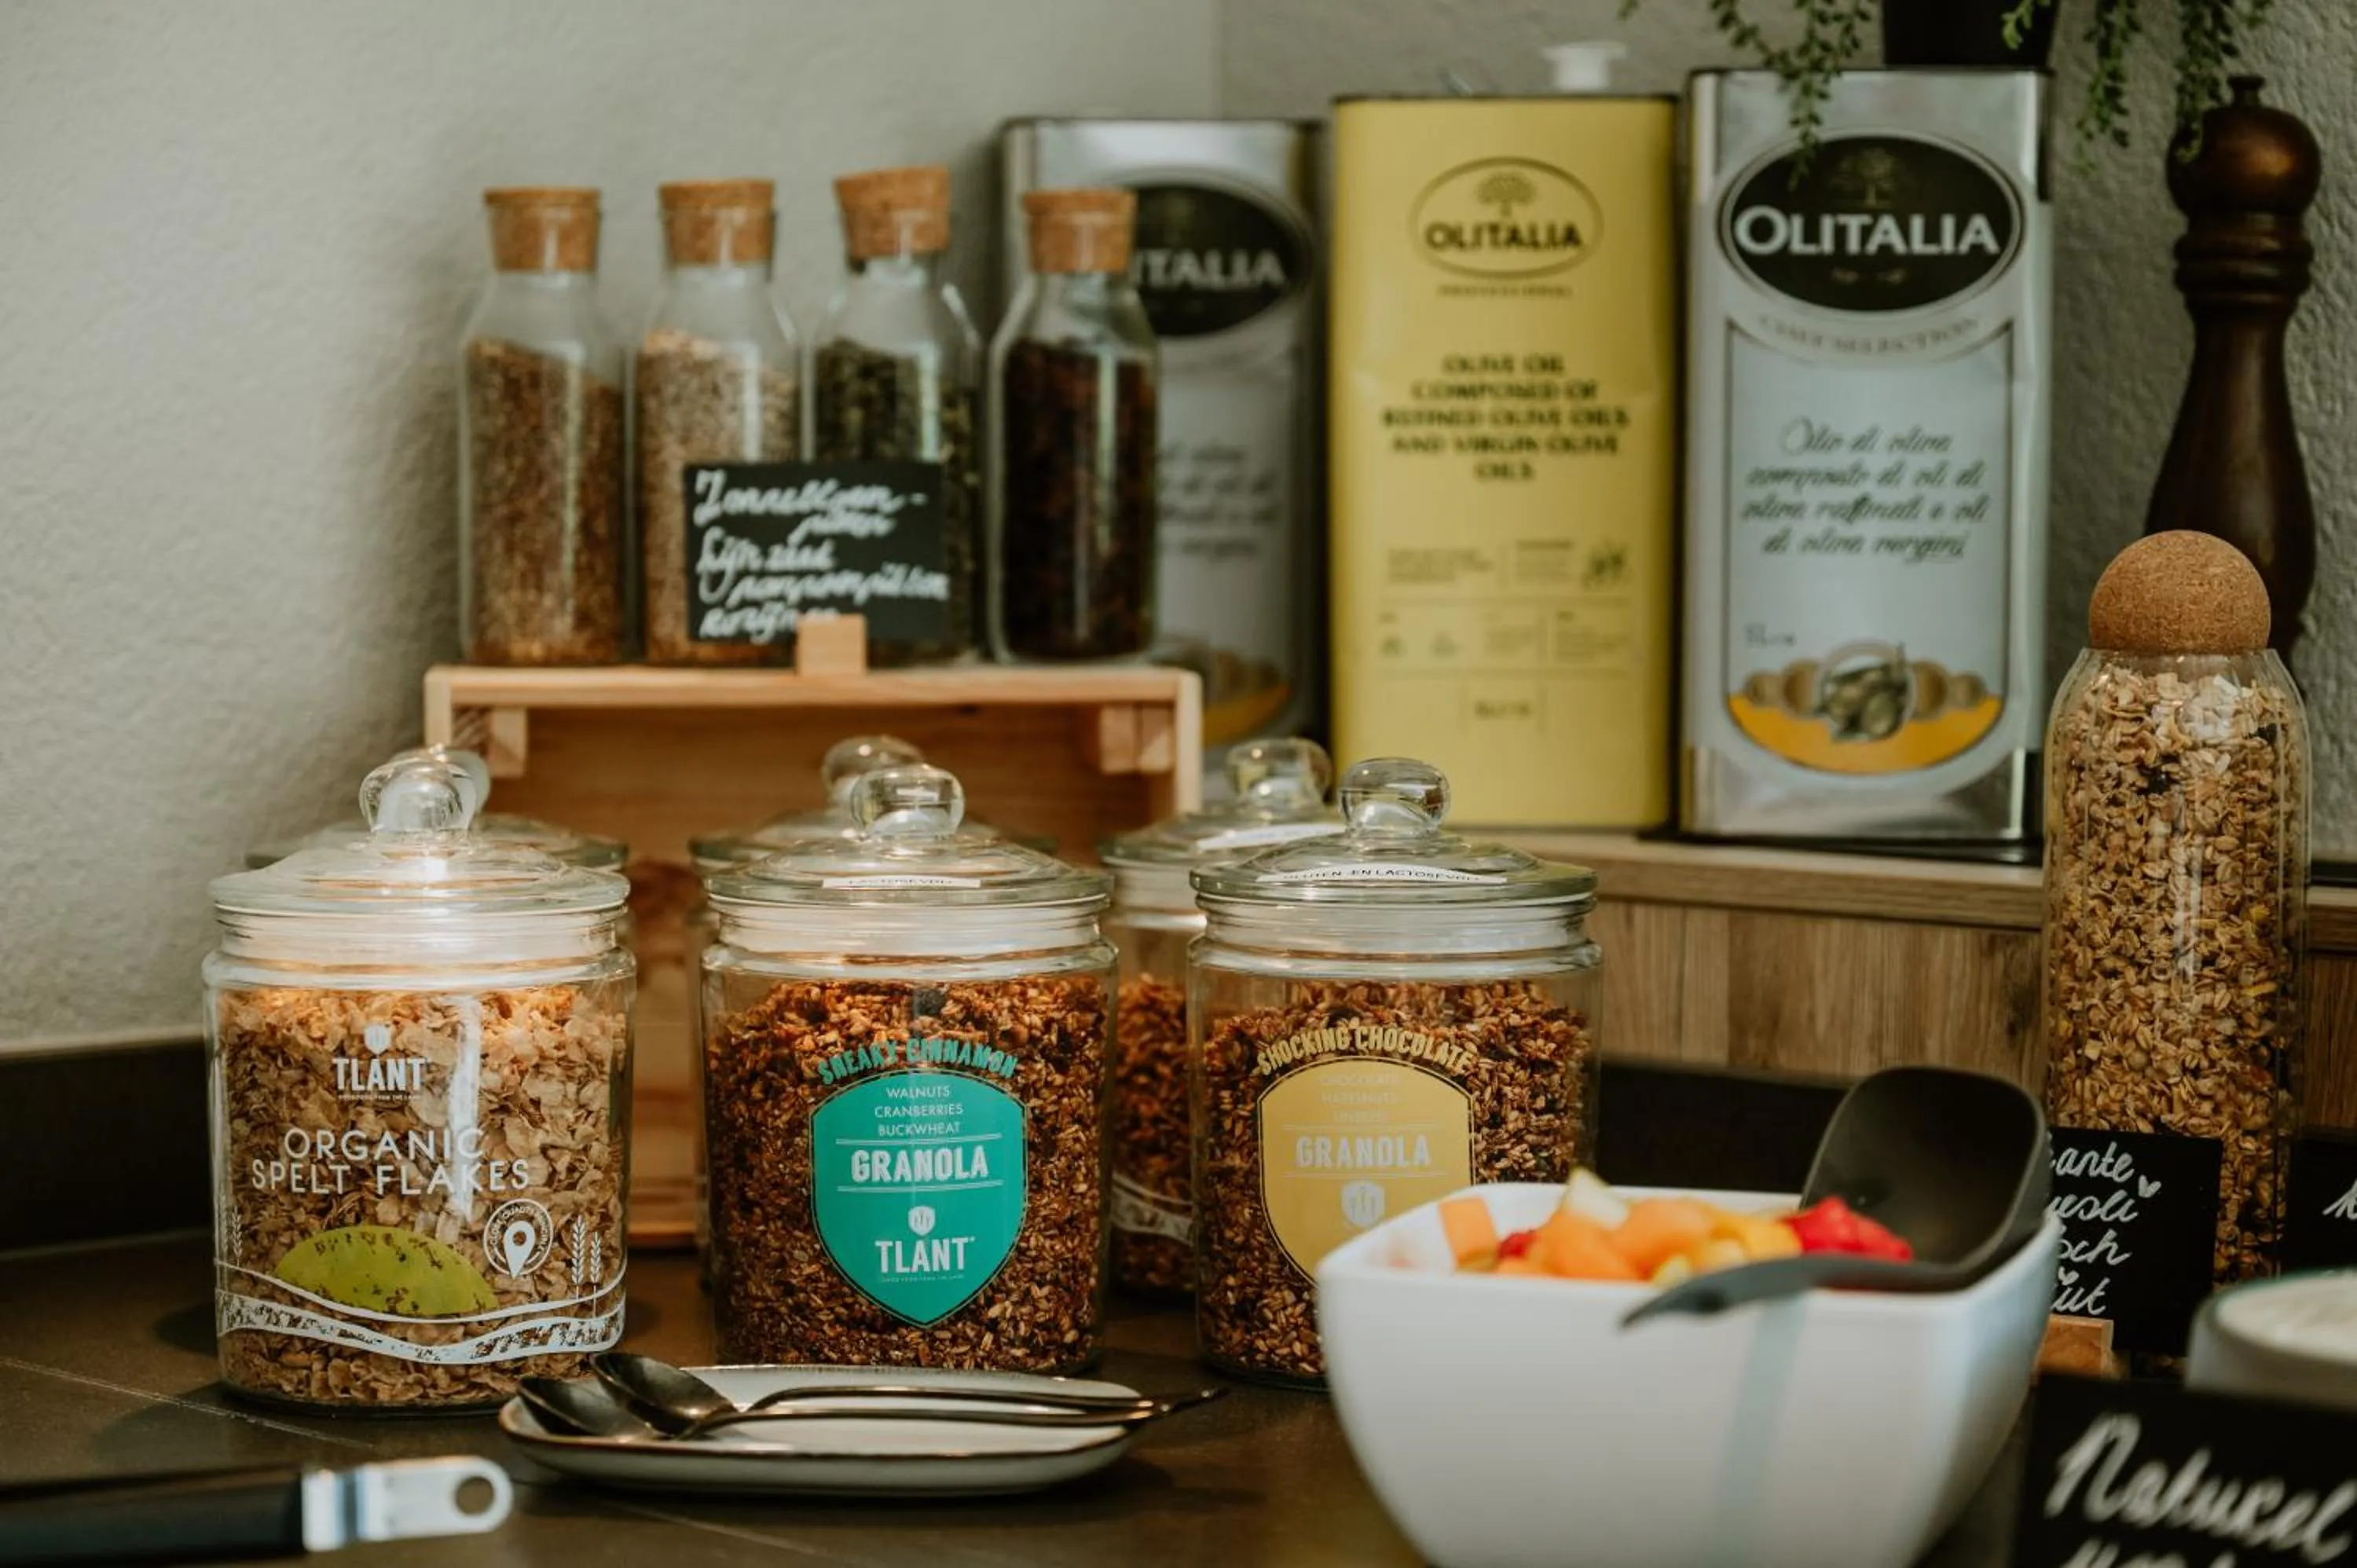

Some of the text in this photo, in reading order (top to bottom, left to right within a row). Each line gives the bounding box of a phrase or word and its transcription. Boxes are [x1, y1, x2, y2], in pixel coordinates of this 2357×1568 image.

[1425, 222, 1583, 251] OLITALIA
[1734, 204, 2000, 255] OLITALIA
[1130, 247, 1286, 290] ITALIA
[818, 1037, 1018, 1084] SNEAKY CINNAMON
[1257, 1025, 1473, 1075] SHOCKING CHOCOLATE
[332, 1057, 427, 1091] TLANT
[885, 1085, 951, 1099] WALNUTS
[874, 1103, 964, 1118] CRANBERRIES
[284, 1127, 485, 1161] ORGANIC
[878, 1122, 961, 1137] BUCKWHEAT
[851, 1146, 988, 1182] GRANOLA
[1296, 1135, 1431, 1168] GRANOLA
[2050, 1141, 2135, 1183] ante
[252, 1159, 530, 1196] SPELT FLAKES
[874, 1237, 971, 1273] TLANT
